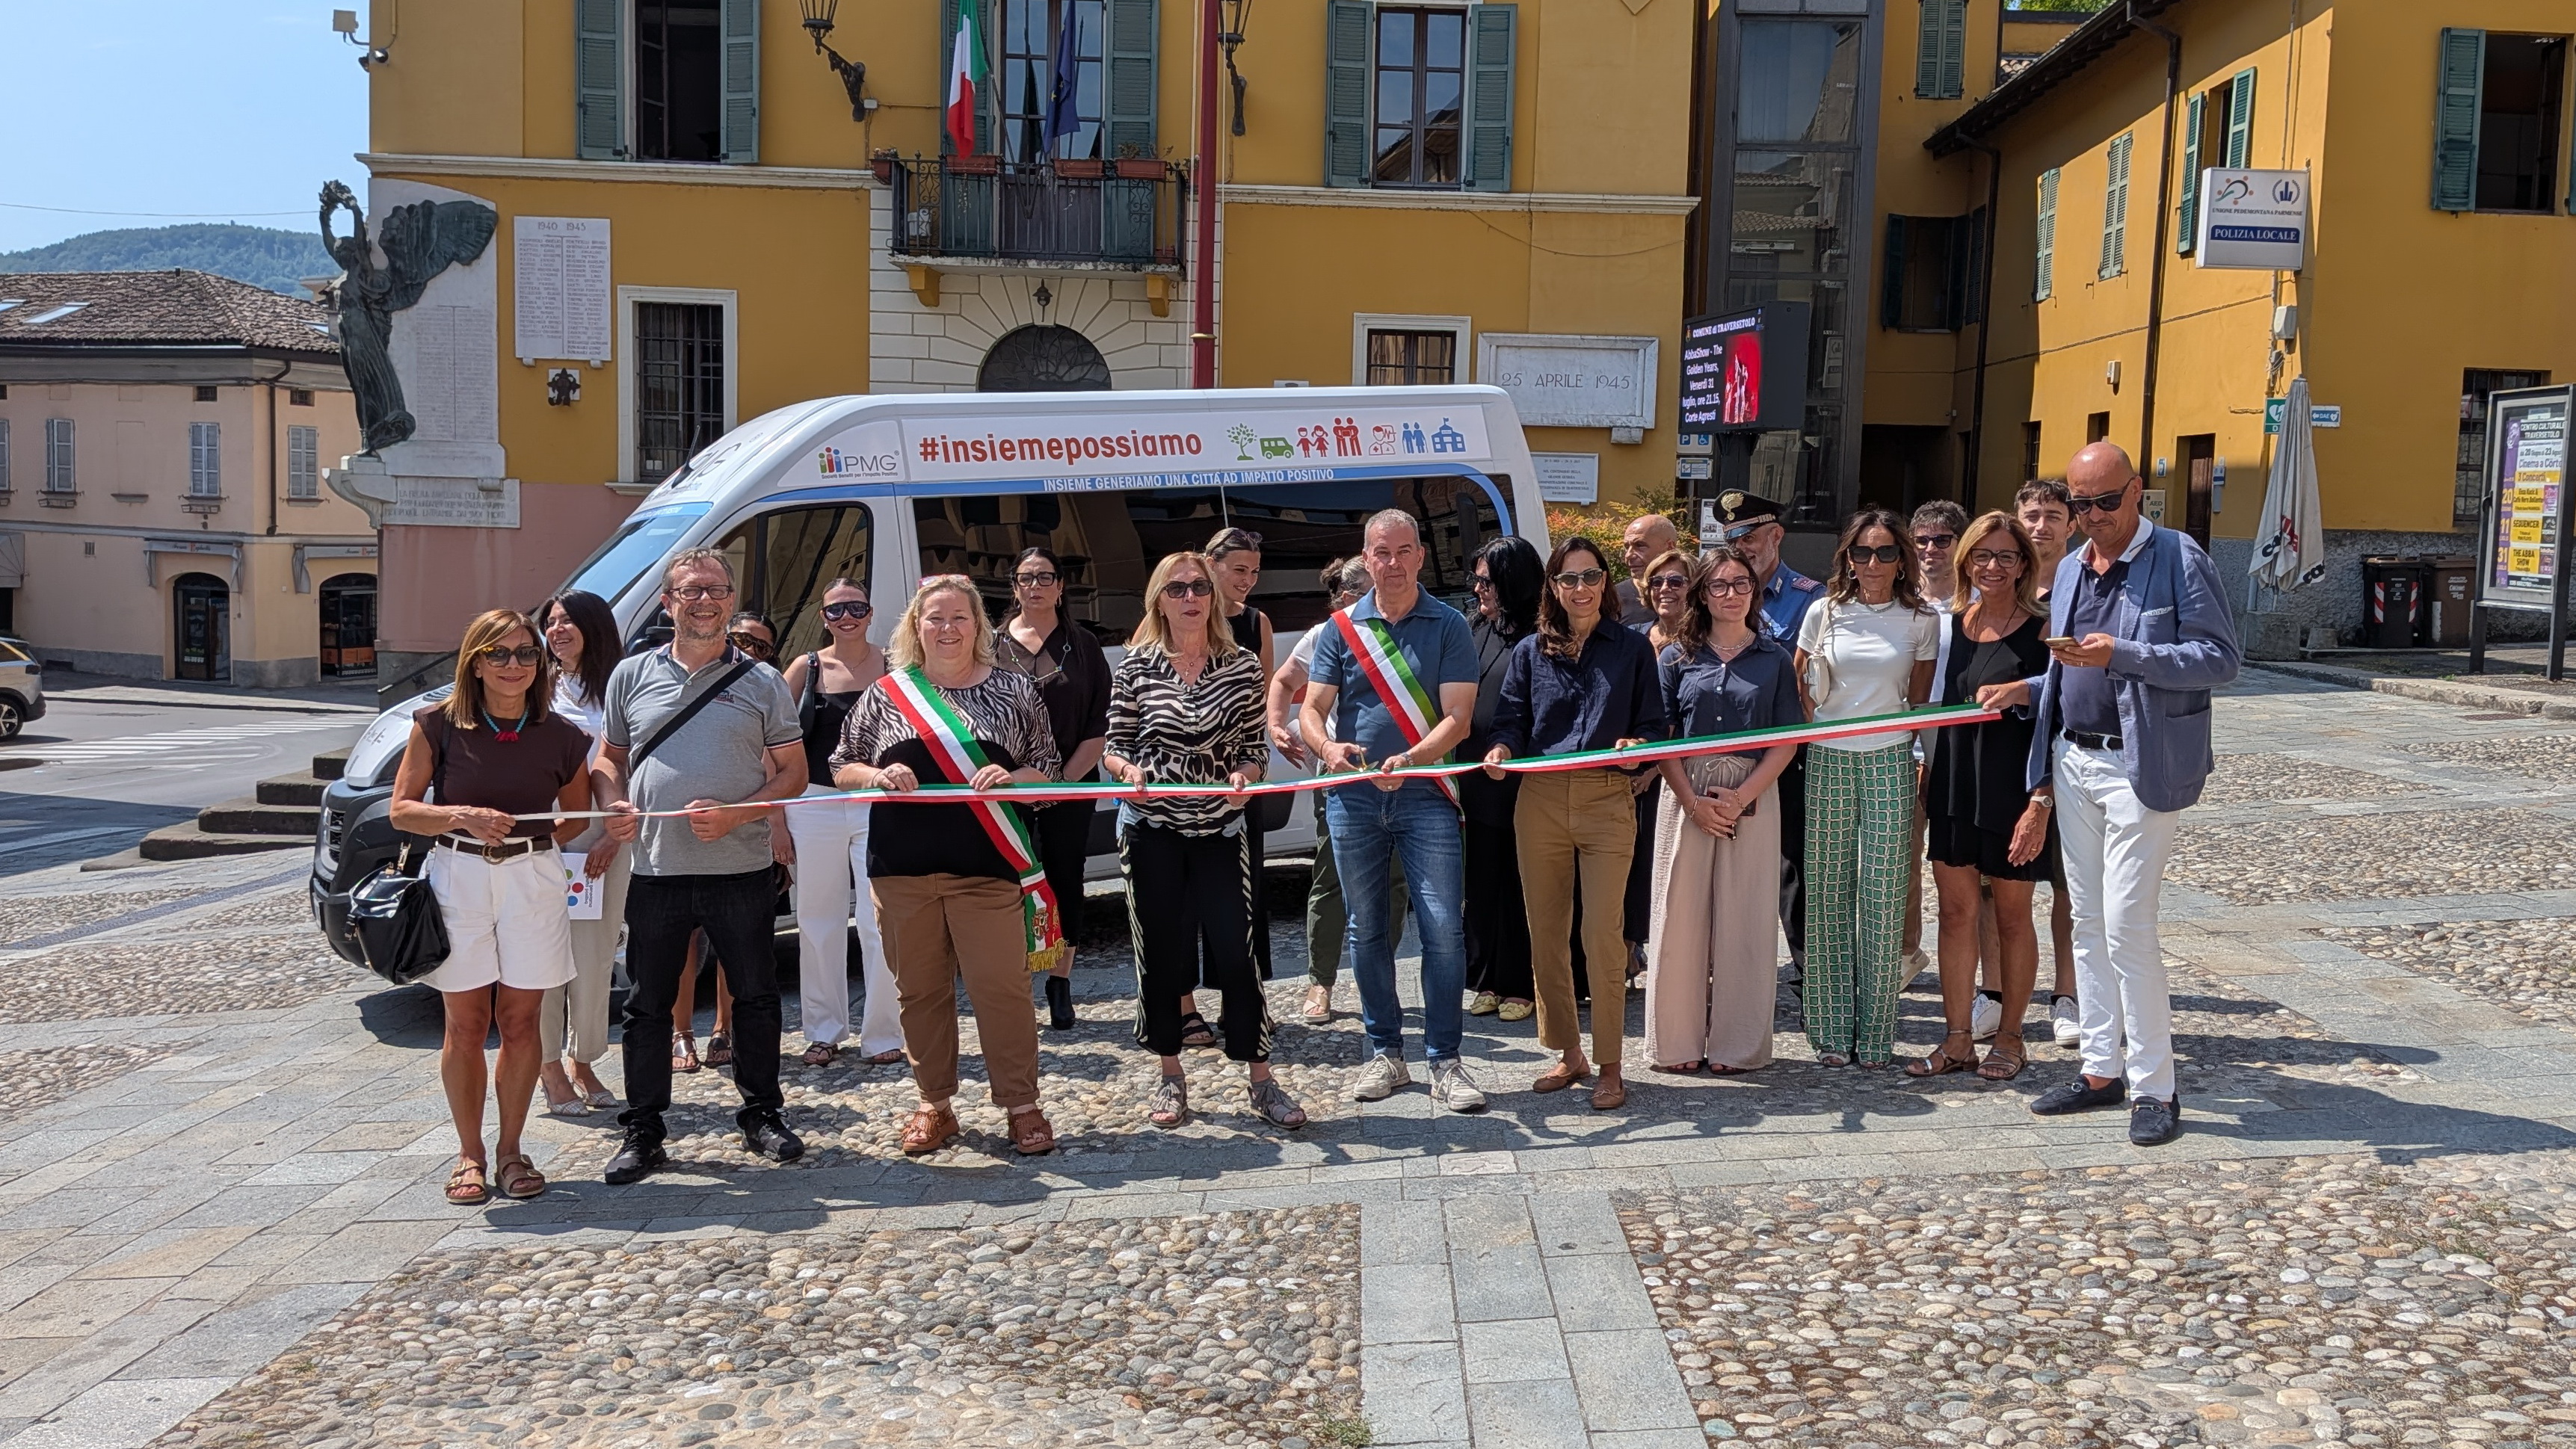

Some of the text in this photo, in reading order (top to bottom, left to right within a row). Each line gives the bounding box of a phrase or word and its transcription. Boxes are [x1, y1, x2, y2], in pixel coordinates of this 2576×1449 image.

[537, 221, 586, 231] 1940 1945
[2214, 228, 2297, 241] POLIZIA LOCALE
[1692, 316, 1756, 338] COMUNE di TRAVERSETOLO
[1684, 347, 1710, 360] AbbaShow
[1713, 344, 1723, 356] The
[1686, 362, 1719, 375] Golden Years,
[1501, 372, 1631, 389] 25 APRILE 1945
[1707, 377, 1714, 389] 31
[1682, 392, 1721, 410] luglio, ore 21.15,
[1685, 410, 1716, 424] Corte Agresti
[2520, 421, 2566, 431] CENTRO CULTURALE
[1681, 433, 1689, 444] P
[919, 430, 1202, 466] #insiemepossiamo
[2545, 448, 2552, 456] 23
[1043, 469, 1334, 492] INSIEME GENERIAMO UNA CITTÀ AD IMPATTO POSITIVO
[2502, 488, 2512, 504] 20
[2500, 519, 2510, 534] 11
[2513, 519, 2539, 528] SEQUENCER
[2497, 547, 2508, 563] 31
[2513, 549, 2521, 557] THE
[2522, 549, 2535, 557] ABBA
[2516, 558, 2530, 566] SHOW
